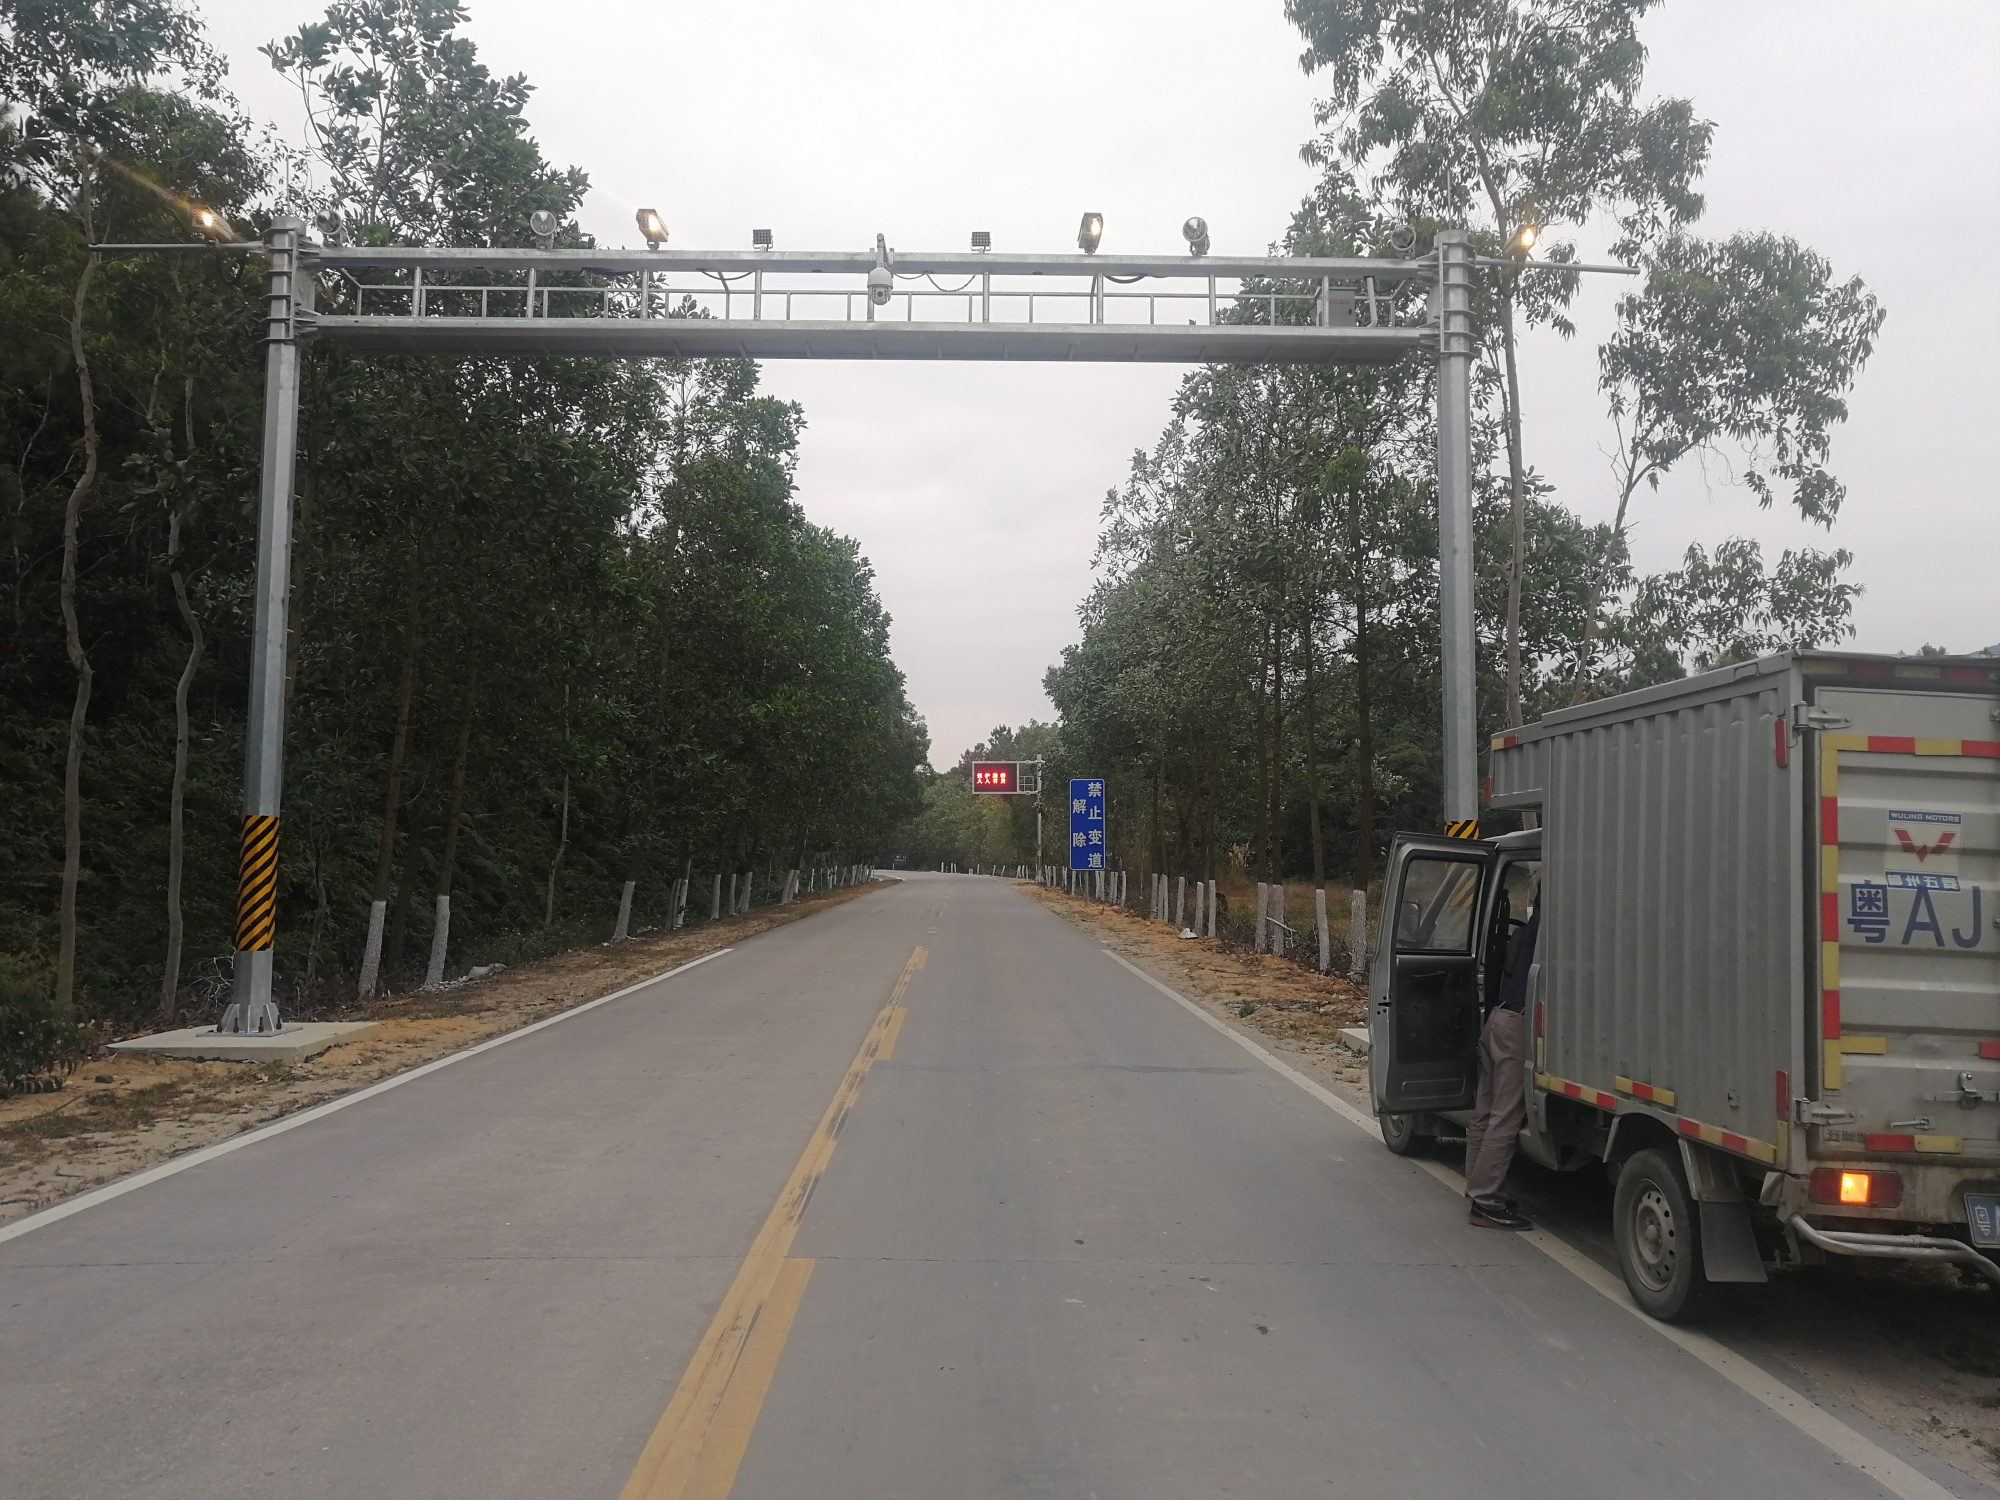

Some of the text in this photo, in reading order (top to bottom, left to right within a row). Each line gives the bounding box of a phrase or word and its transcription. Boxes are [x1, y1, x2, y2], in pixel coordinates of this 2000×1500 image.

[1072, 799, 1086, 847] 解除
[1088, 782, 1102, 868] 禁止变道
[1890, 812, 1960, 823] WULING MOTORS
[1887, 874, 1959, 890] 柳州五菱
[1975, 1204, 2000, 1236] 粤
